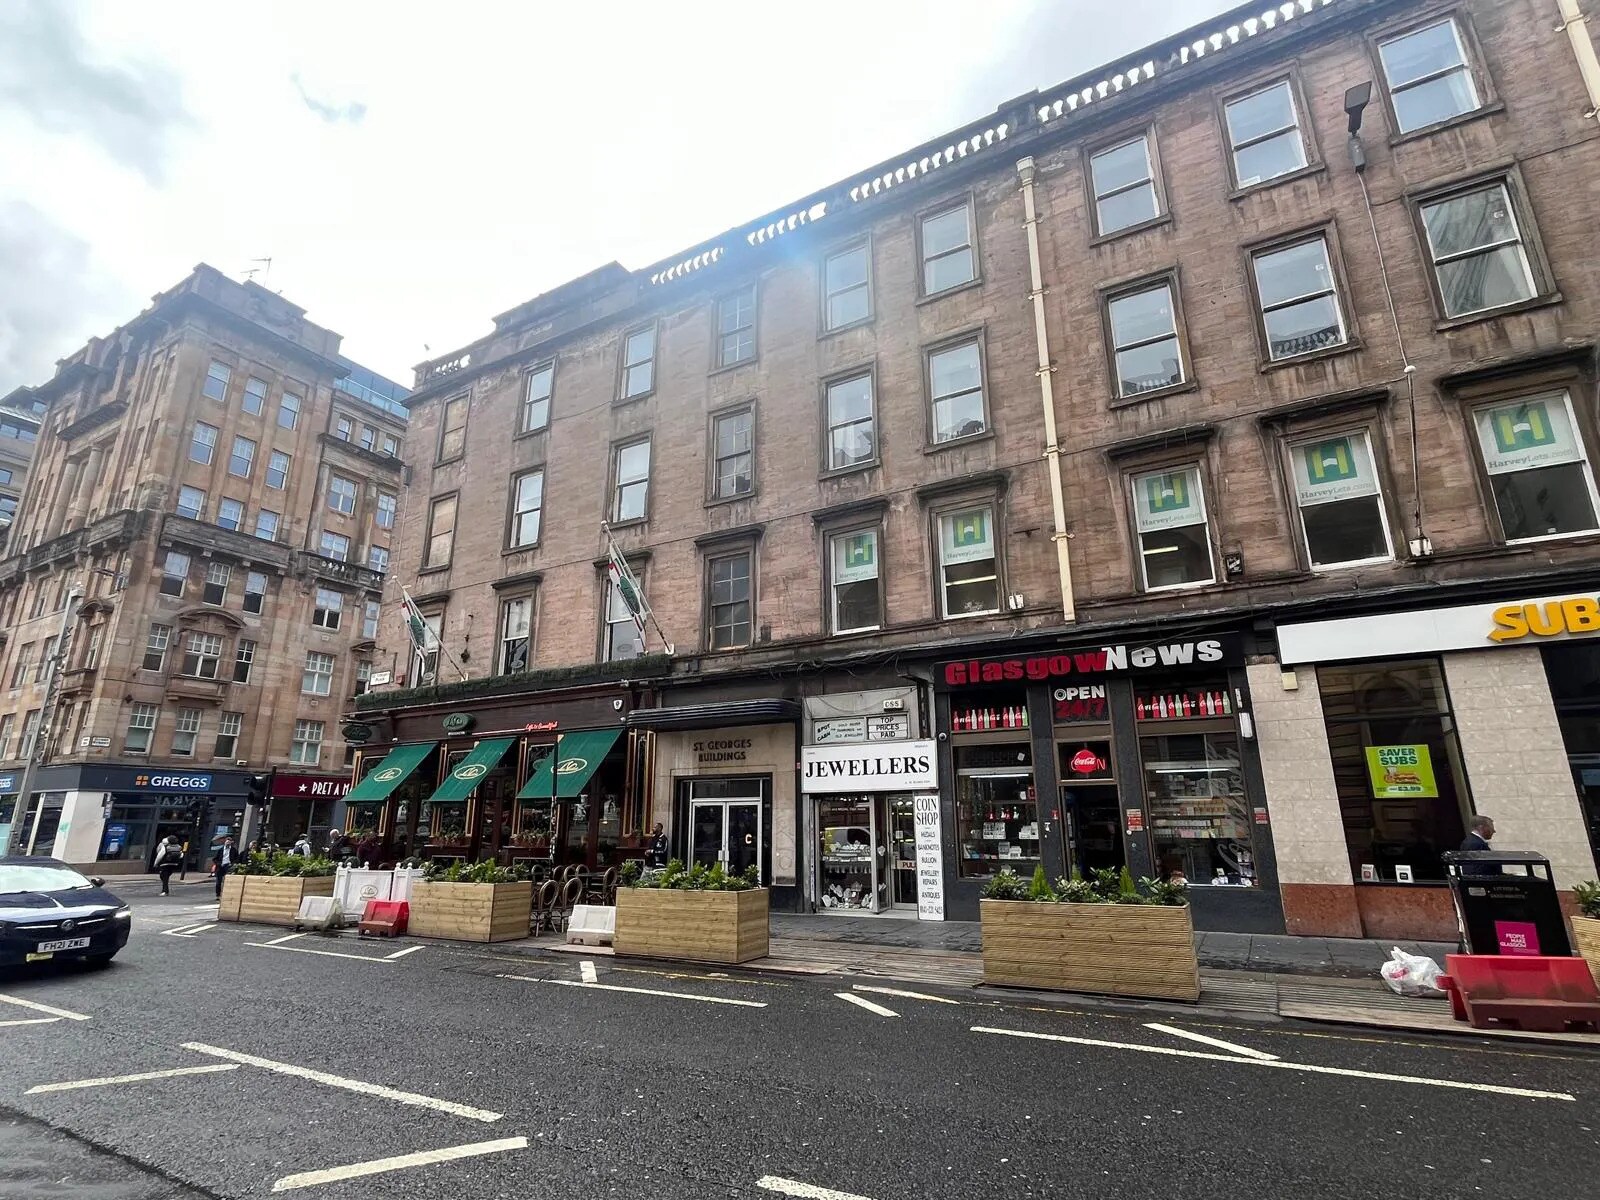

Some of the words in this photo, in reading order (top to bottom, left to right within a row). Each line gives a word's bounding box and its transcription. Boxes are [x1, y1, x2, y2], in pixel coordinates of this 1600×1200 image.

[1488, 449, 1573, 468] HarveyLets.com
[1301, 483, 1371, 499] HarveyLets.com
[1487, 597, 1600, 643] SUB
[1054, 685, 1105, 700] OPEN
[1055, 700, 1105, 718] 24/7
[708, 739, 752, 750] GEORGES
[698, 751, 746, 762] BUILDINGS
[1379, 748, 1416, 756] SAVER
[805, 756, 930, 778] JEWELLERS
[1380, 756, 1417, 765] SUBS
[151, 775, 208, 787] GREGGS
[311, 782, 332, 795] PRET
[333, 785, 340, 795] A
[342, 784, 352, 796] M
[916, 798, 937, 811] COIN
[916, 812, 938, 825] SHOP
